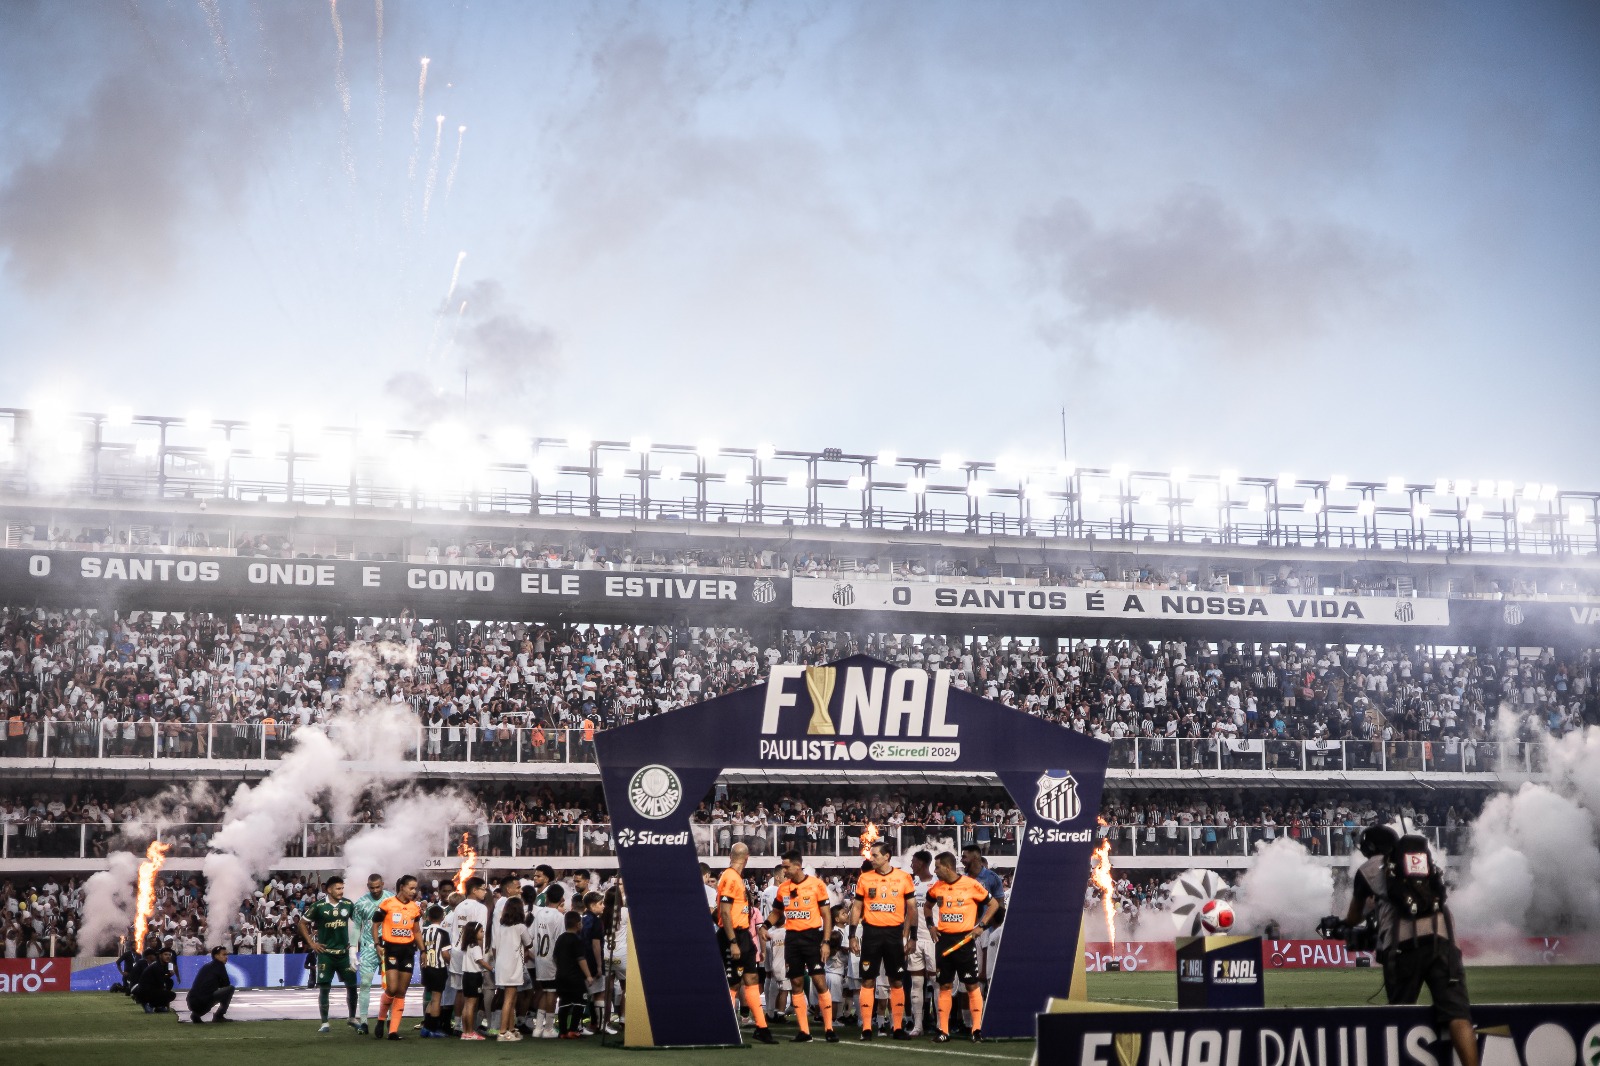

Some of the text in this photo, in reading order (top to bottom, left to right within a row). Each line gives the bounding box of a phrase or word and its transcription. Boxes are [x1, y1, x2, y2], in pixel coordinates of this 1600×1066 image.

[29, 554, 738, 601] O SANTOS ONDE E COMO ELE ESTIVER
[892, 586, 1366, 620] O SANTOS É A NOSSA VIDA
[887, 745, 929, 757] Sicredi
[931, 747, 958, 757] 2024
[631, 787, 679, 816] PALMEIRAS
[637, 830, 689, 845] Sicredi
[1046, 828, 1092, 842] Sicredi
